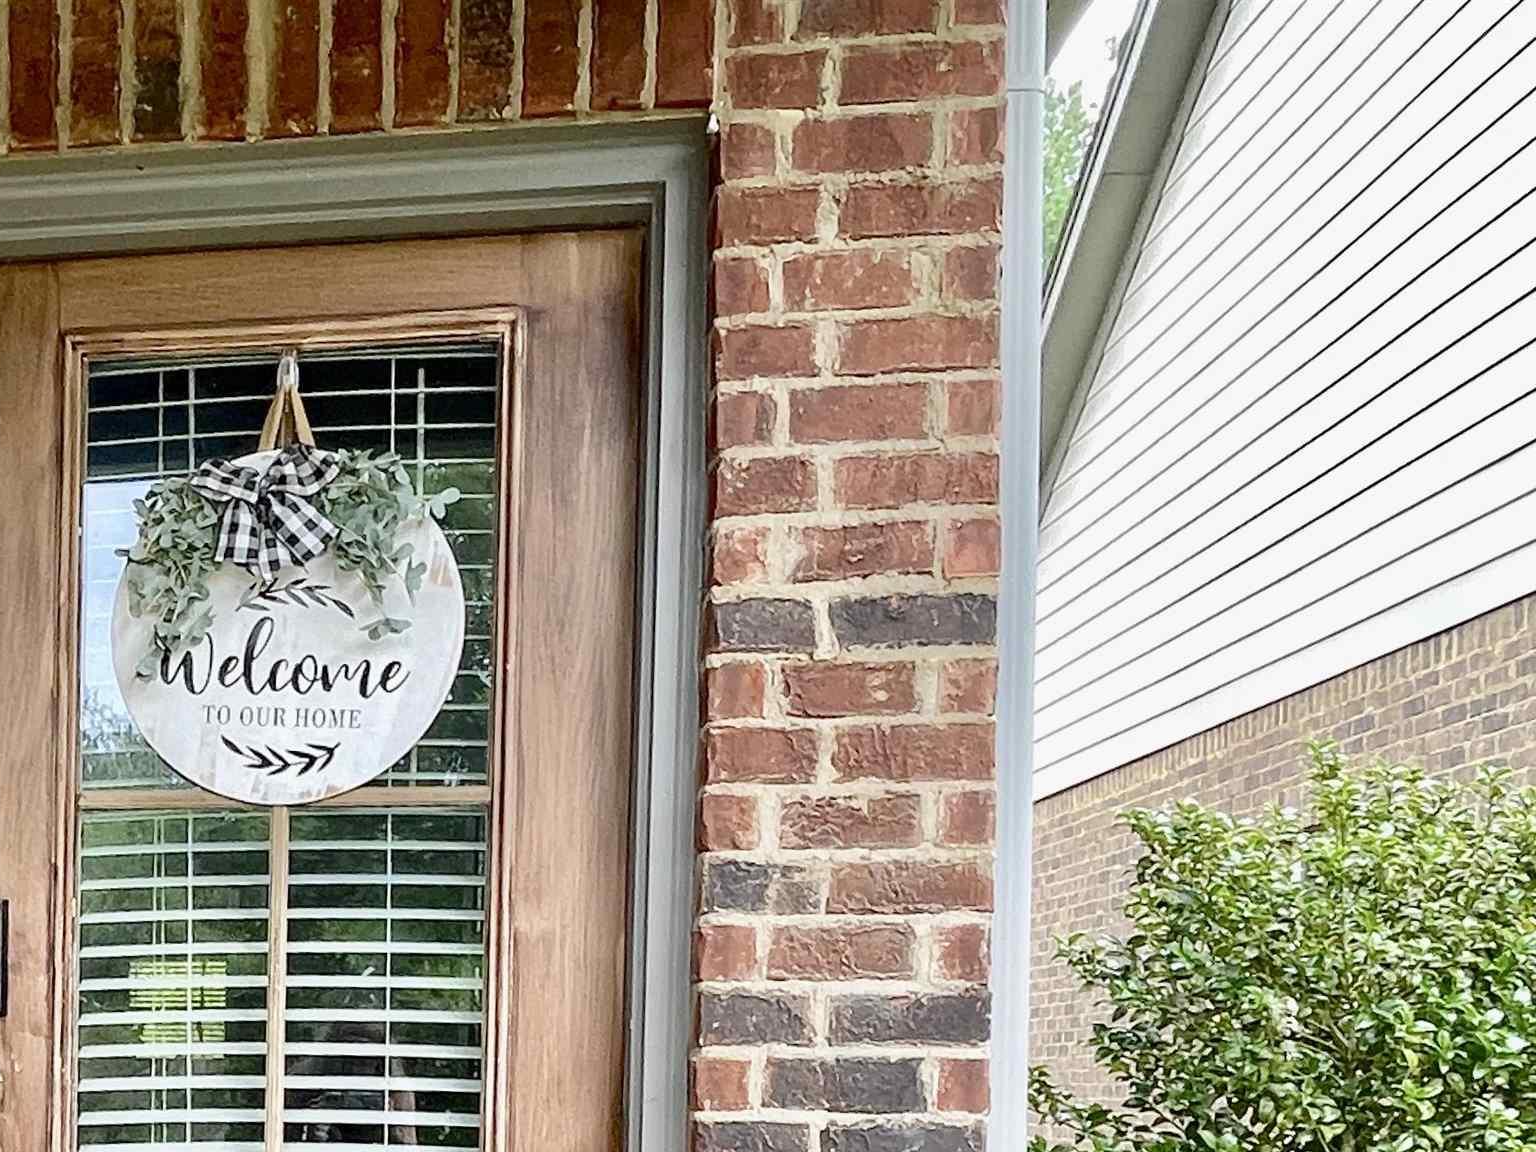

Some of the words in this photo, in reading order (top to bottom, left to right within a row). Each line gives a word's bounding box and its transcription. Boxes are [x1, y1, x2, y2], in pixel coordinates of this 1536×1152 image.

[156, 616, 410, 698] Welcome
[202, 705, 231, 725] TO
[240, 706, 286, 727] OUR
[295, 707, 362, 729] HOME
